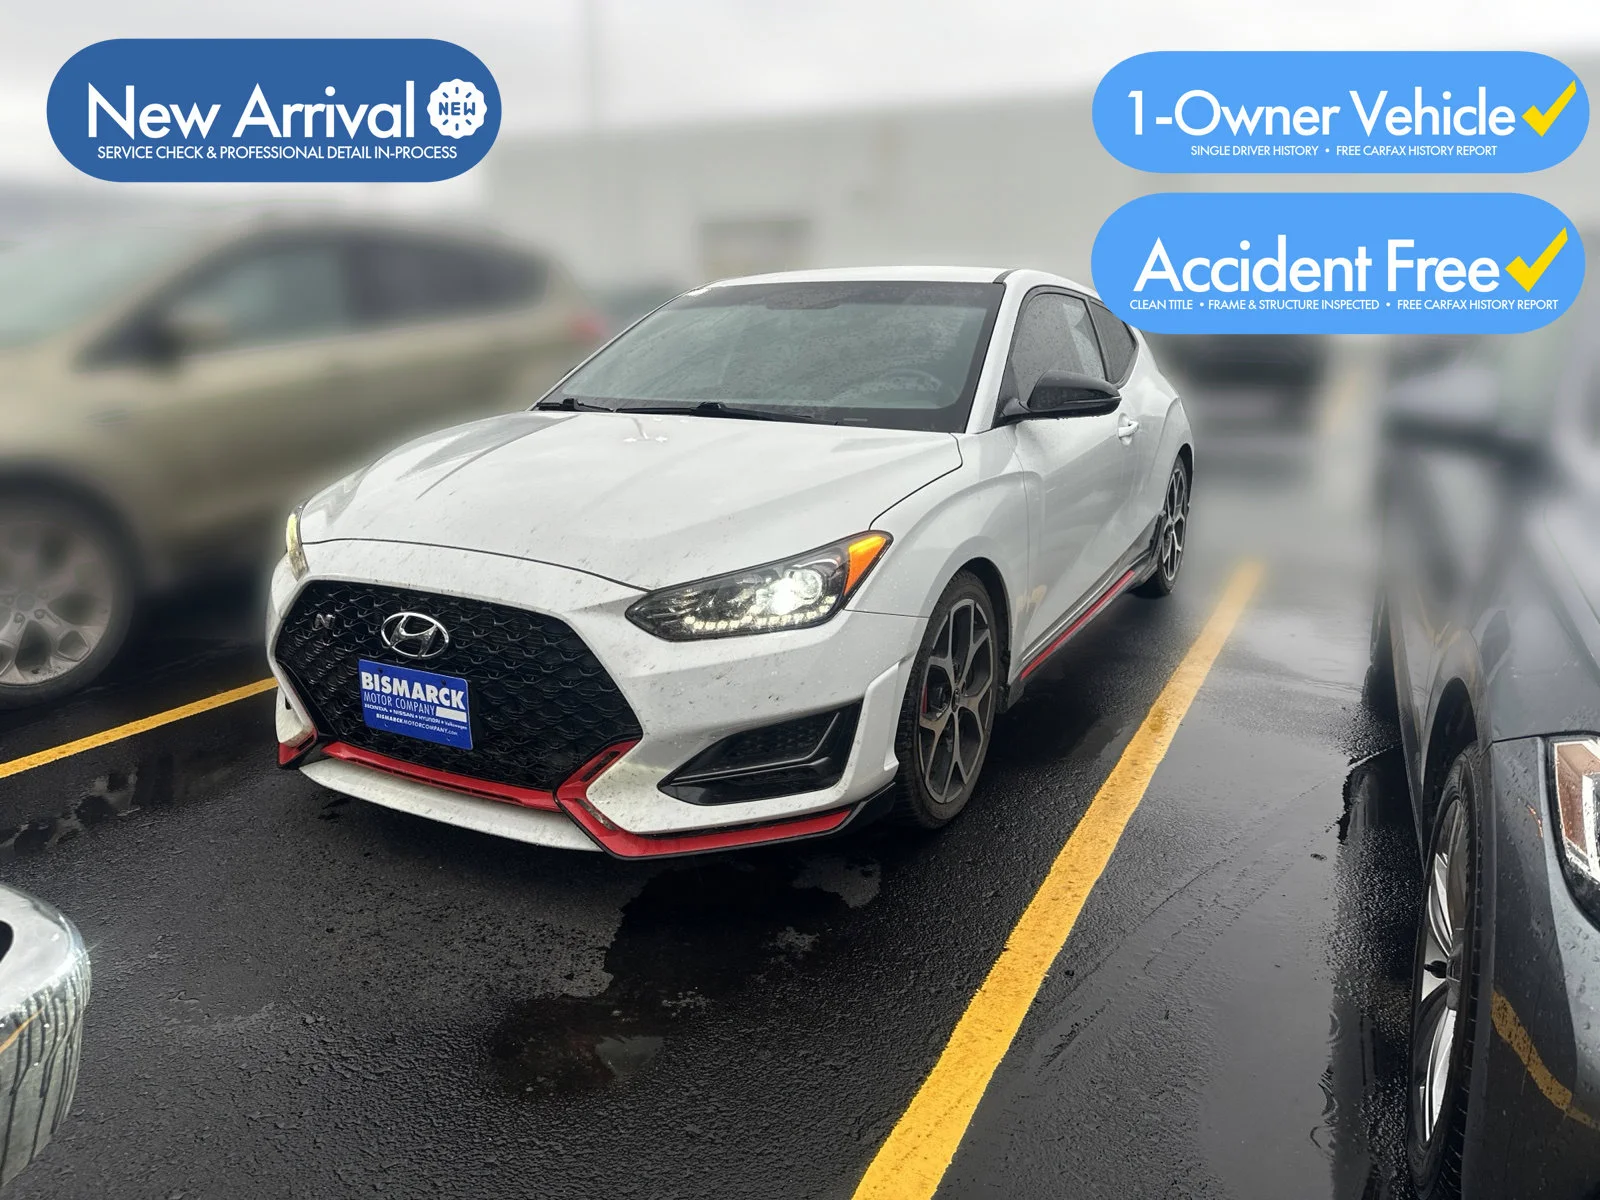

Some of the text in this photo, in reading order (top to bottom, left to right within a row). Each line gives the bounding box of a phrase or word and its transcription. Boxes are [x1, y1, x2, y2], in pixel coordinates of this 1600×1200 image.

[361, 671, 466, 710] BISMARCK
[363, 691, 435, 716] MOTOR COMPANY
